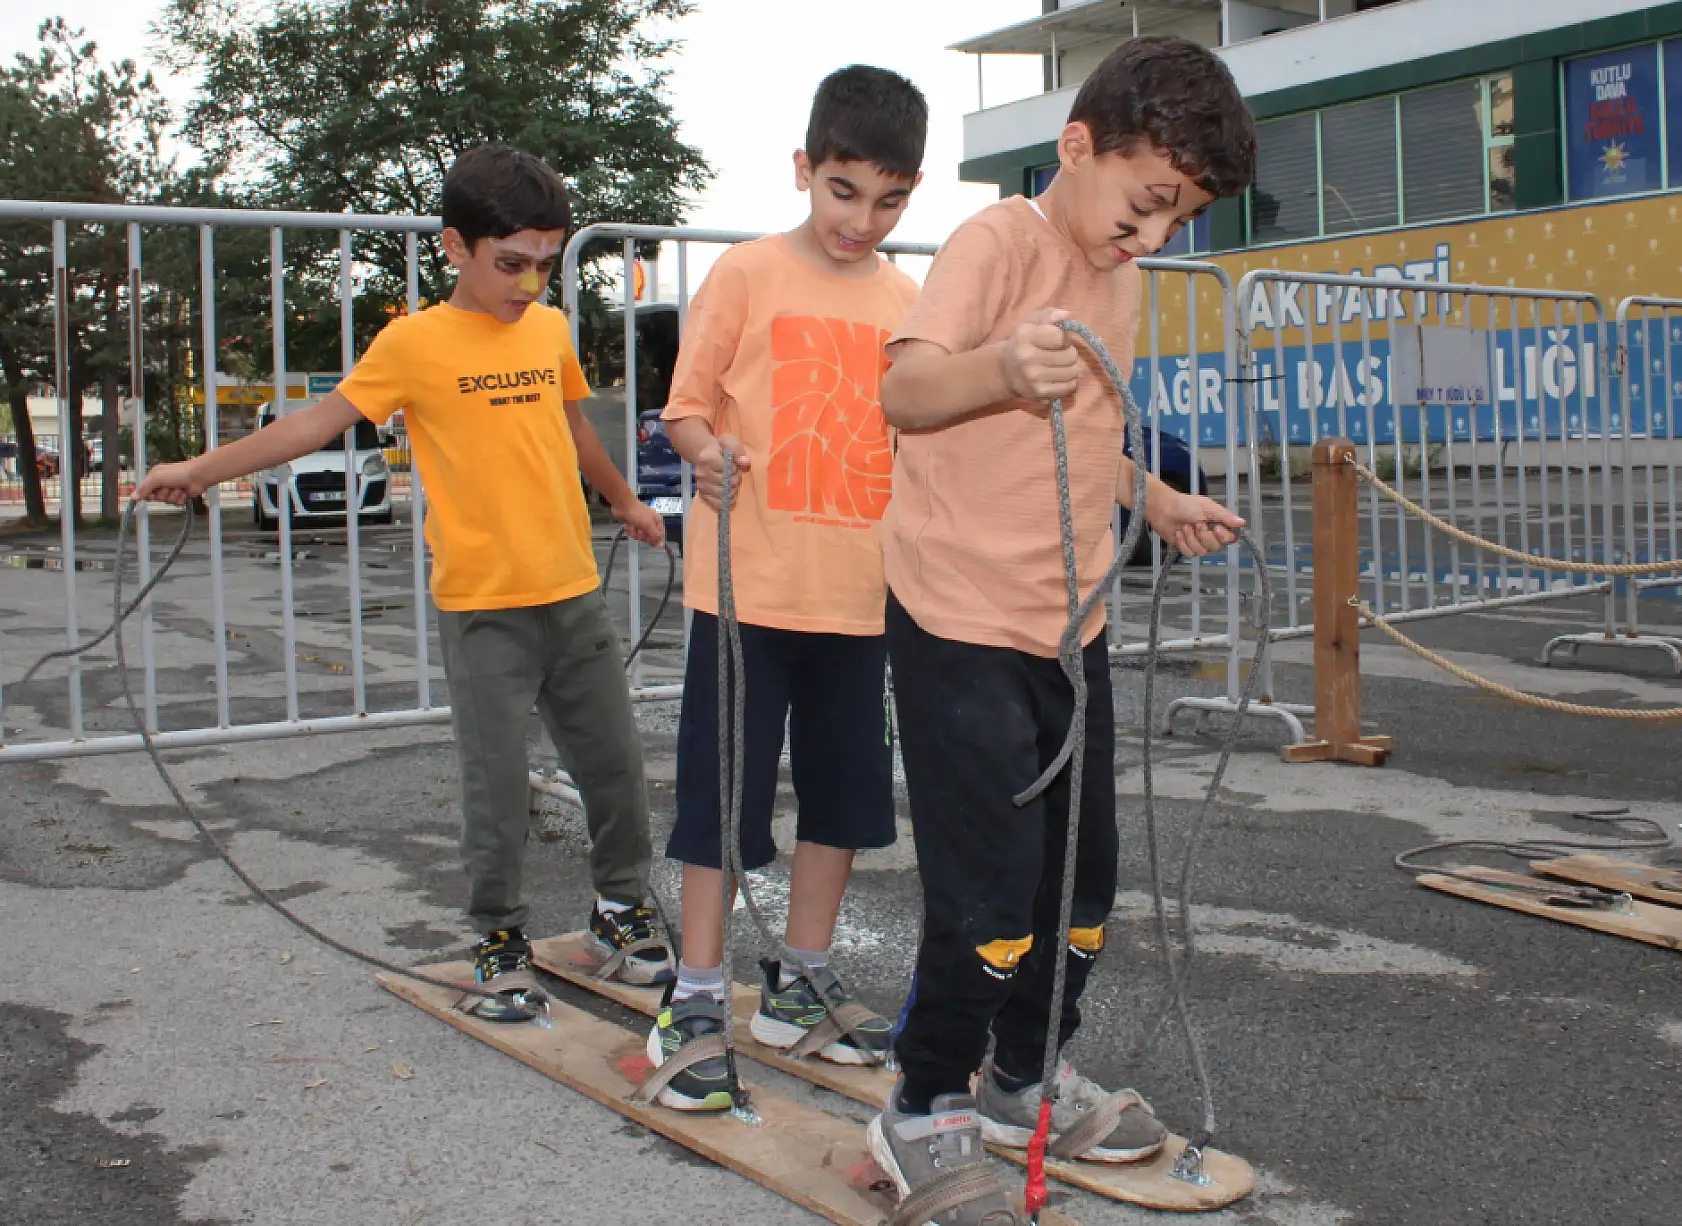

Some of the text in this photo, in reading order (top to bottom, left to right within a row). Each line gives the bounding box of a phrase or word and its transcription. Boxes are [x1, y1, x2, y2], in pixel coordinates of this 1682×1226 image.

[1250, 280, 1305, 330] AK
[458, 369, 555, 393] EXCLUSIVE
[1147, 358, 1225, 417] AĞR
